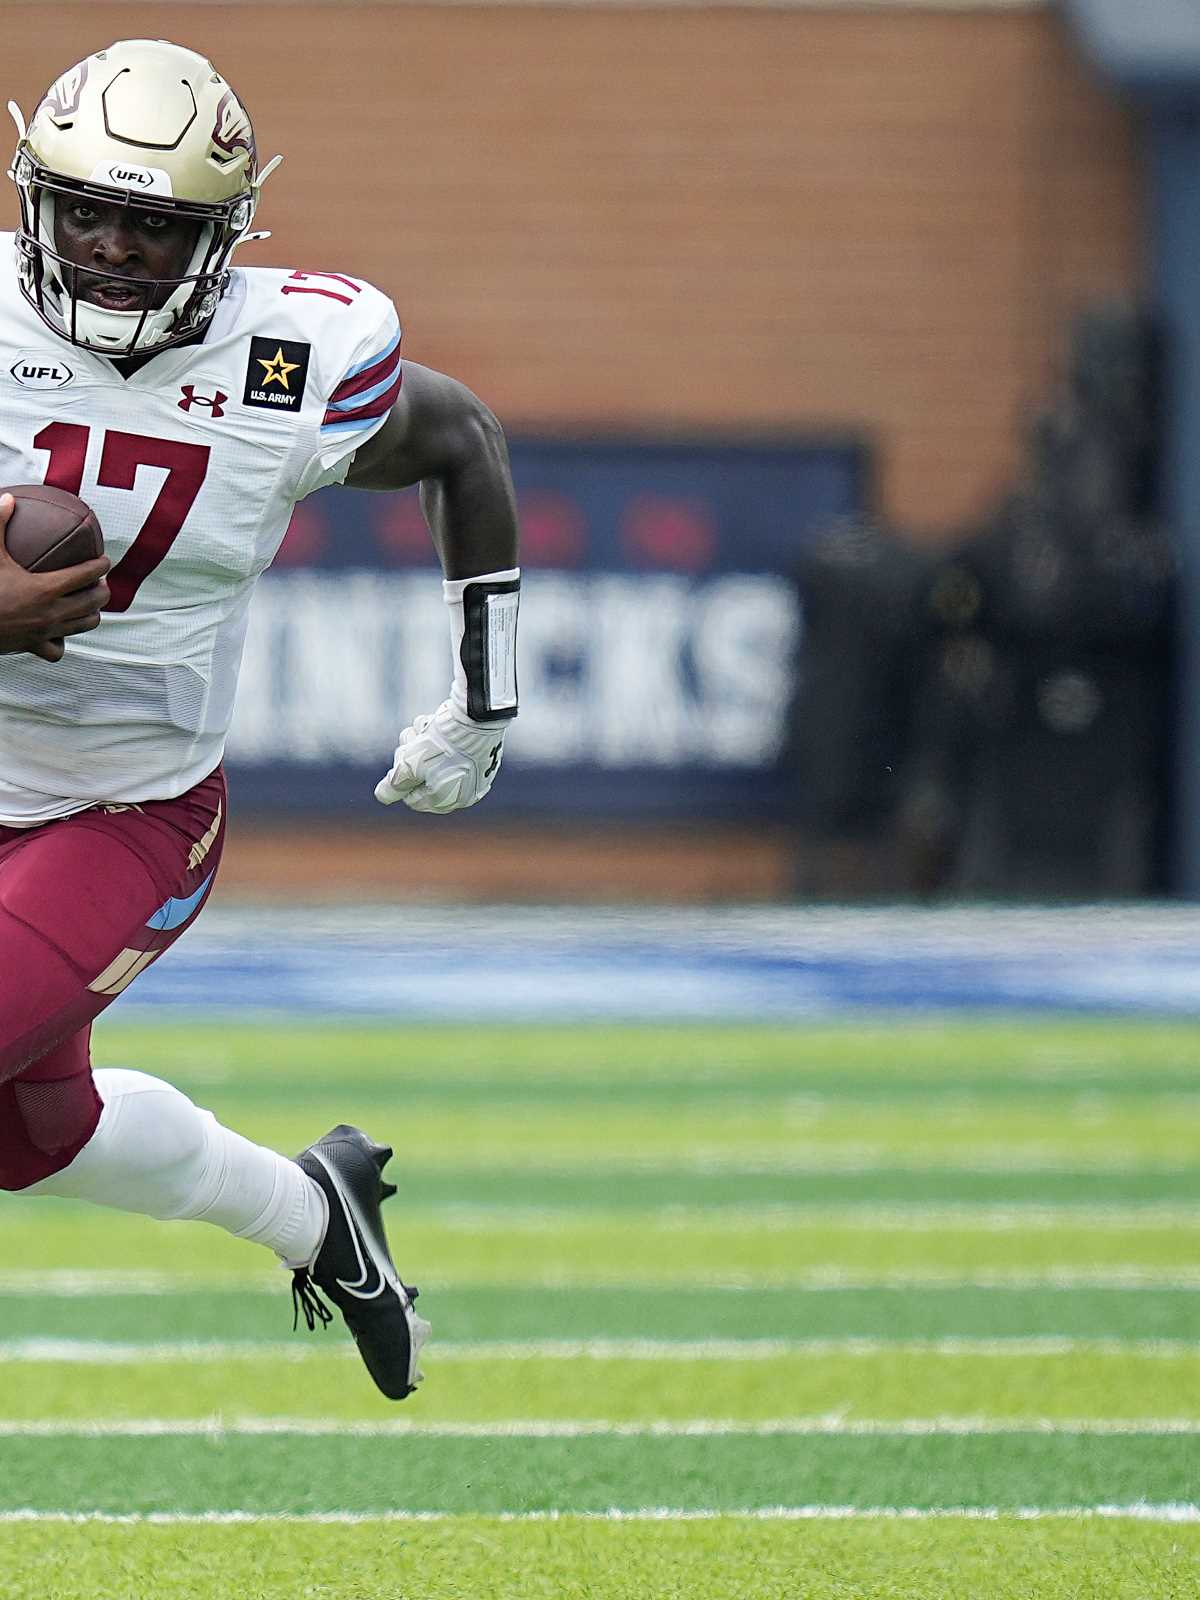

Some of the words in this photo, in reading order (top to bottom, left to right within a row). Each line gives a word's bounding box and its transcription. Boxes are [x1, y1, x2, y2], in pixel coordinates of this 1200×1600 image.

[116, 170, 146, 184] UFL
[280, 270, 362, 306] 17
[21, 366, 63, 380] UFL
[250, 390, 268, 402] U.S.
[267, 392, 296, 405] ARMY
[32, 420, 212, 614] 17
